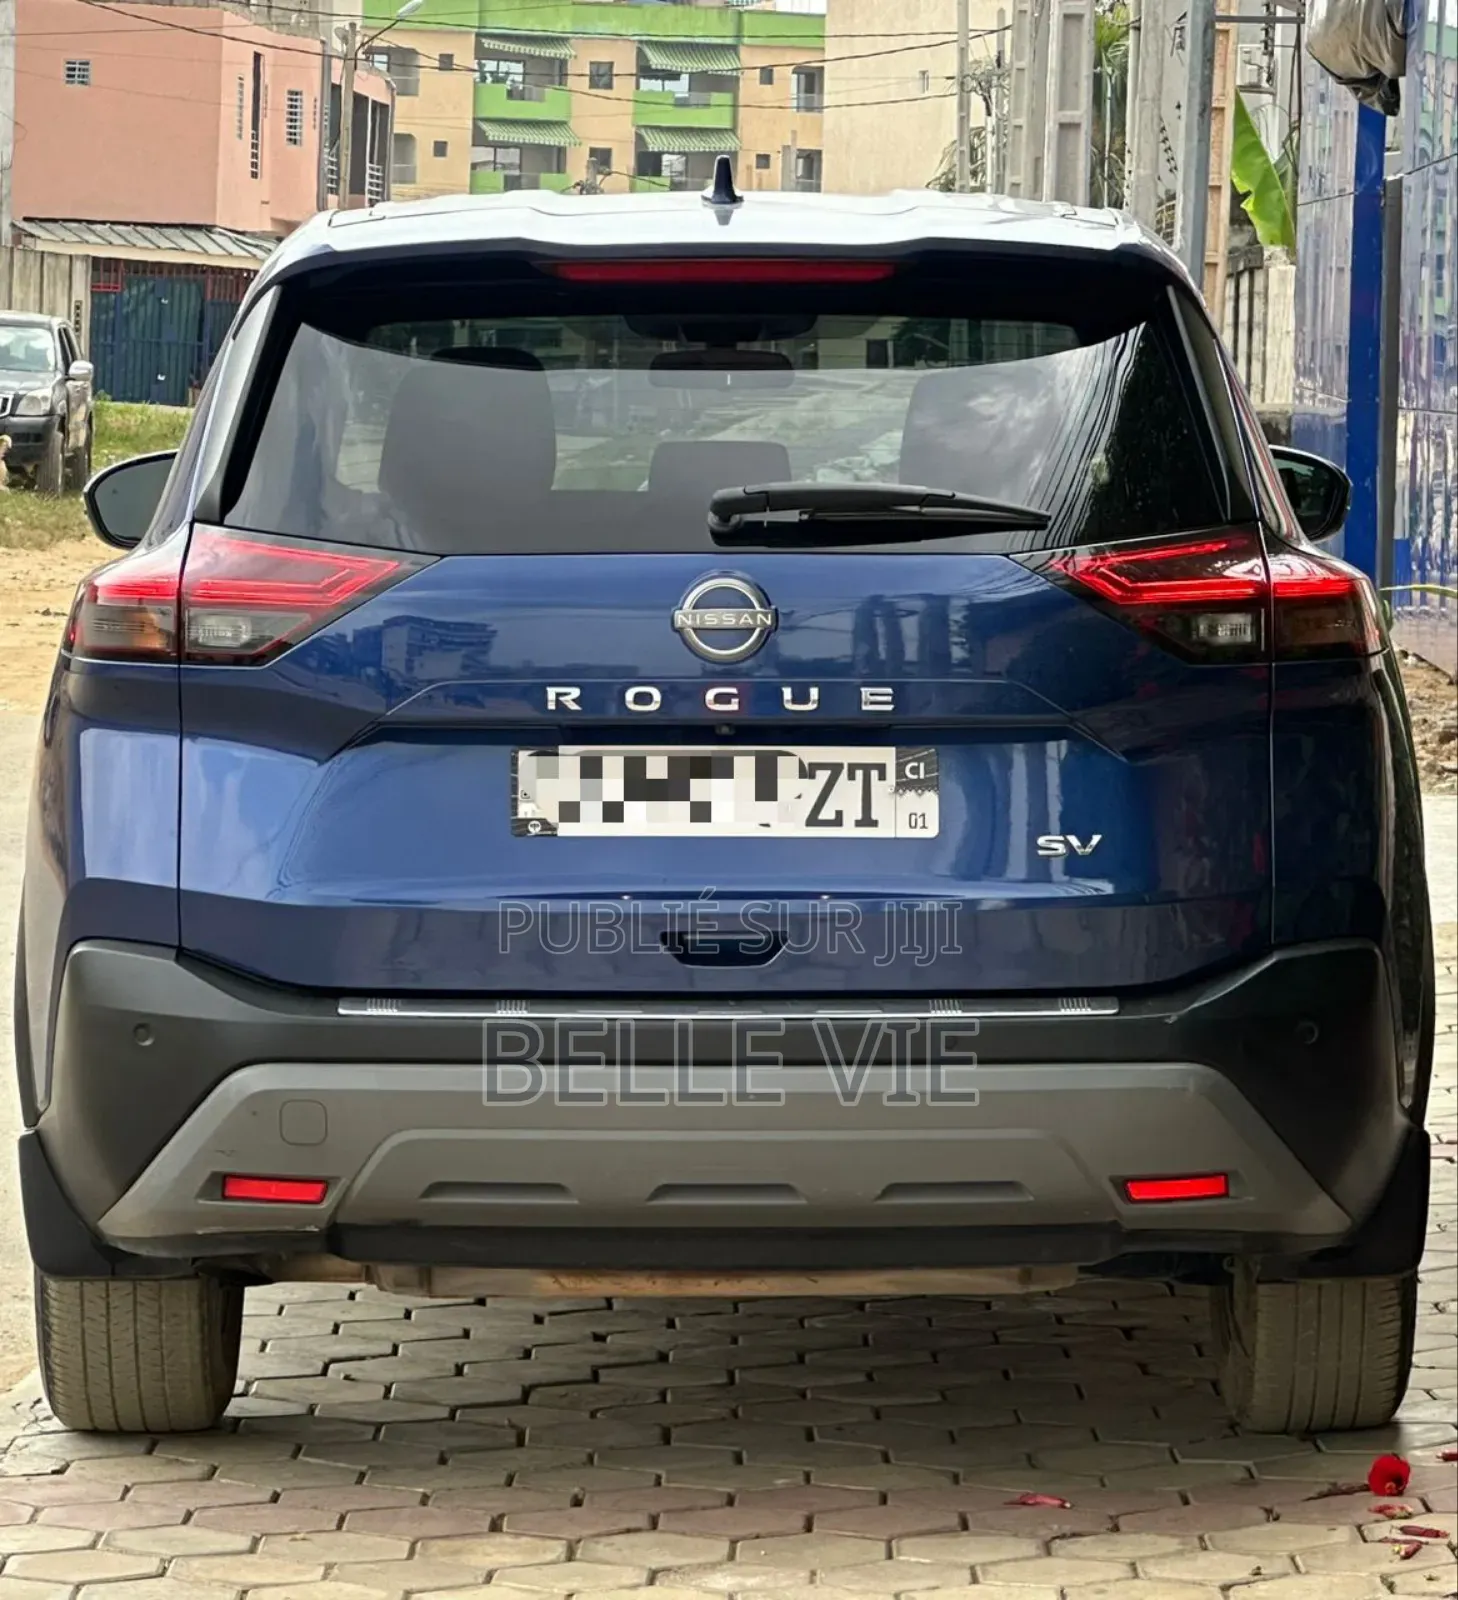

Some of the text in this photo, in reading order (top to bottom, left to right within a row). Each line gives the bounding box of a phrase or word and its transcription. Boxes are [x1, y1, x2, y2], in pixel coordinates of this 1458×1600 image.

[677, 612, 772, 625] NISSAN
[546, 686, 895, 711] ROGUE
[905, 761, 925, 780] CI
[805, 762, 886, 828] ZT
[908, 812, 928, 830] 01
[1036, 834, 1102, 857] SV
